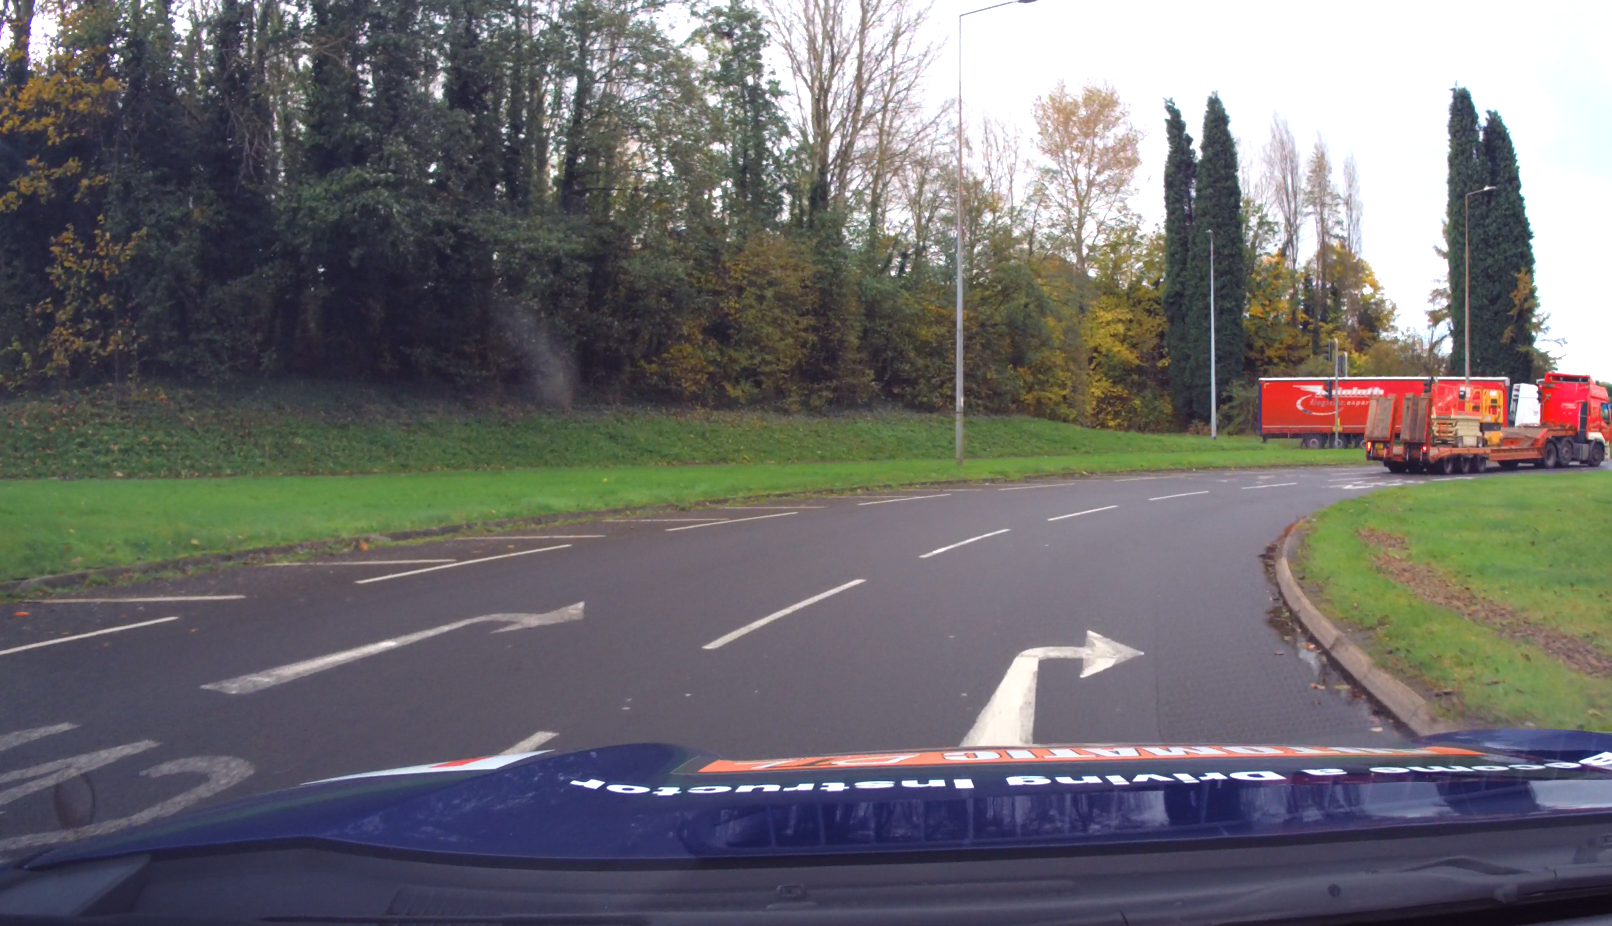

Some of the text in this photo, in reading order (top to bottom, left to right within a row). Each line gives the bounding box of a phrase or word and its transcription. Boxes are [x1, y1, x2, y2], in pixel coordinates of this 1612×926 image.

[942, 746, 1436, 761] AUTOMATIC
[1005, 770, 1287, 786] Driving
[1302, 768, 1347, 776] a
[570, 778, 974, 796] Instructor
